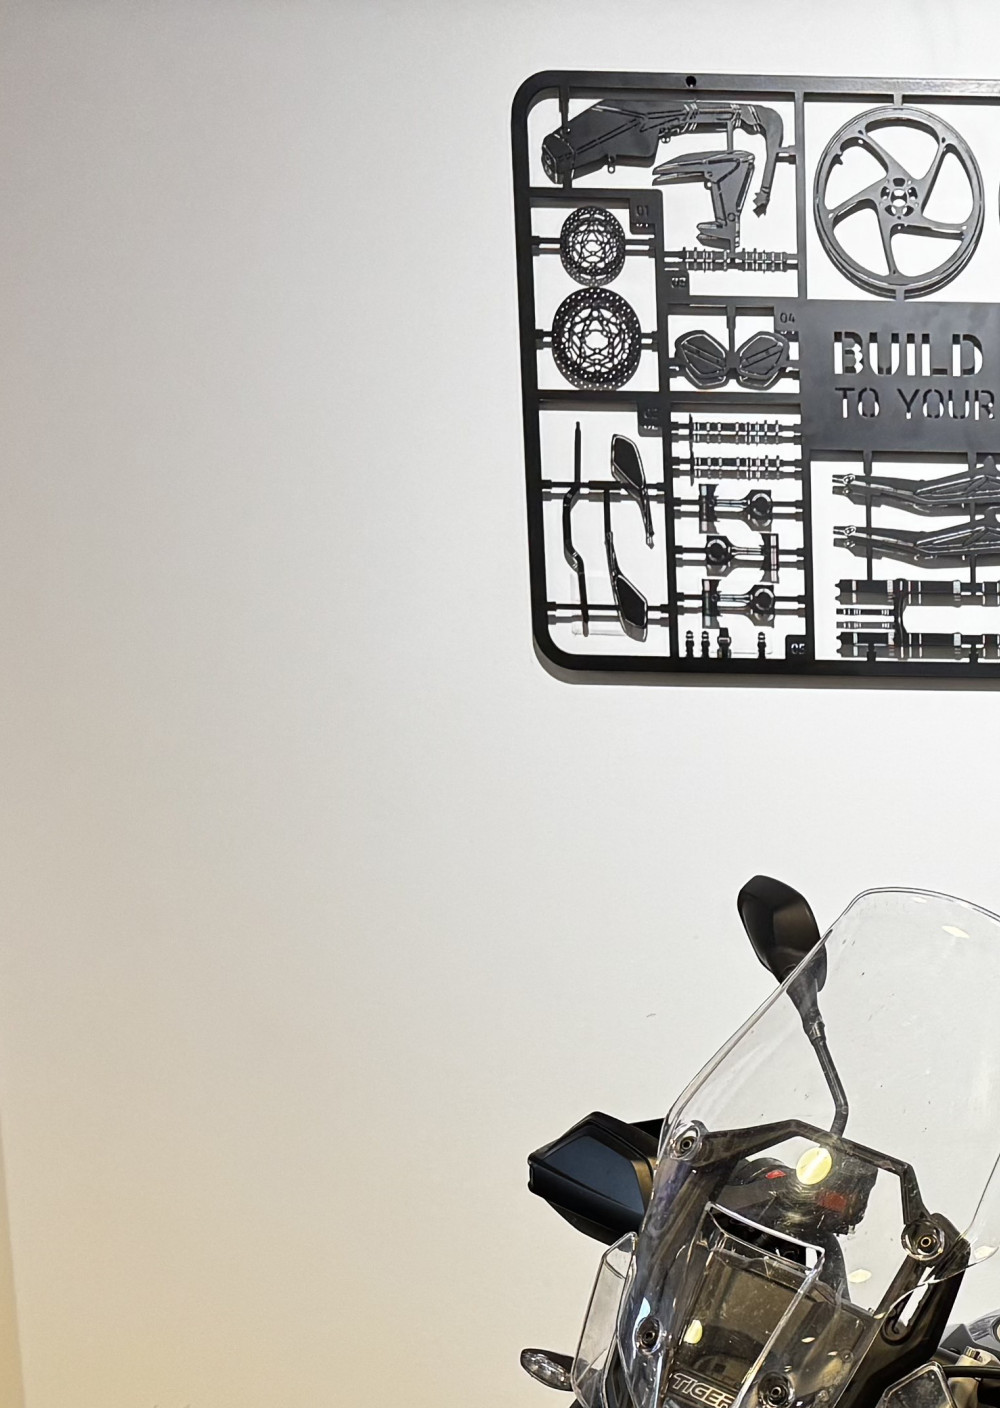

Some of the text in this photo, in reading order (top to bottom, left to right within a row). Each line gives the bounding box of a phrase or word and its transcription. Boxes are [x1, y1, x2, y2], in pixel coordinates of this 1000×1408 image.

[636, 204, 649, 217] 01
[779, 311, 796, 324] 04
[833, 331, 983, 377] BUILD
[835, 387, 880, 419] TO
[897, 388, 995, 421] YOUR
[790, 641, 806, 655] 05
